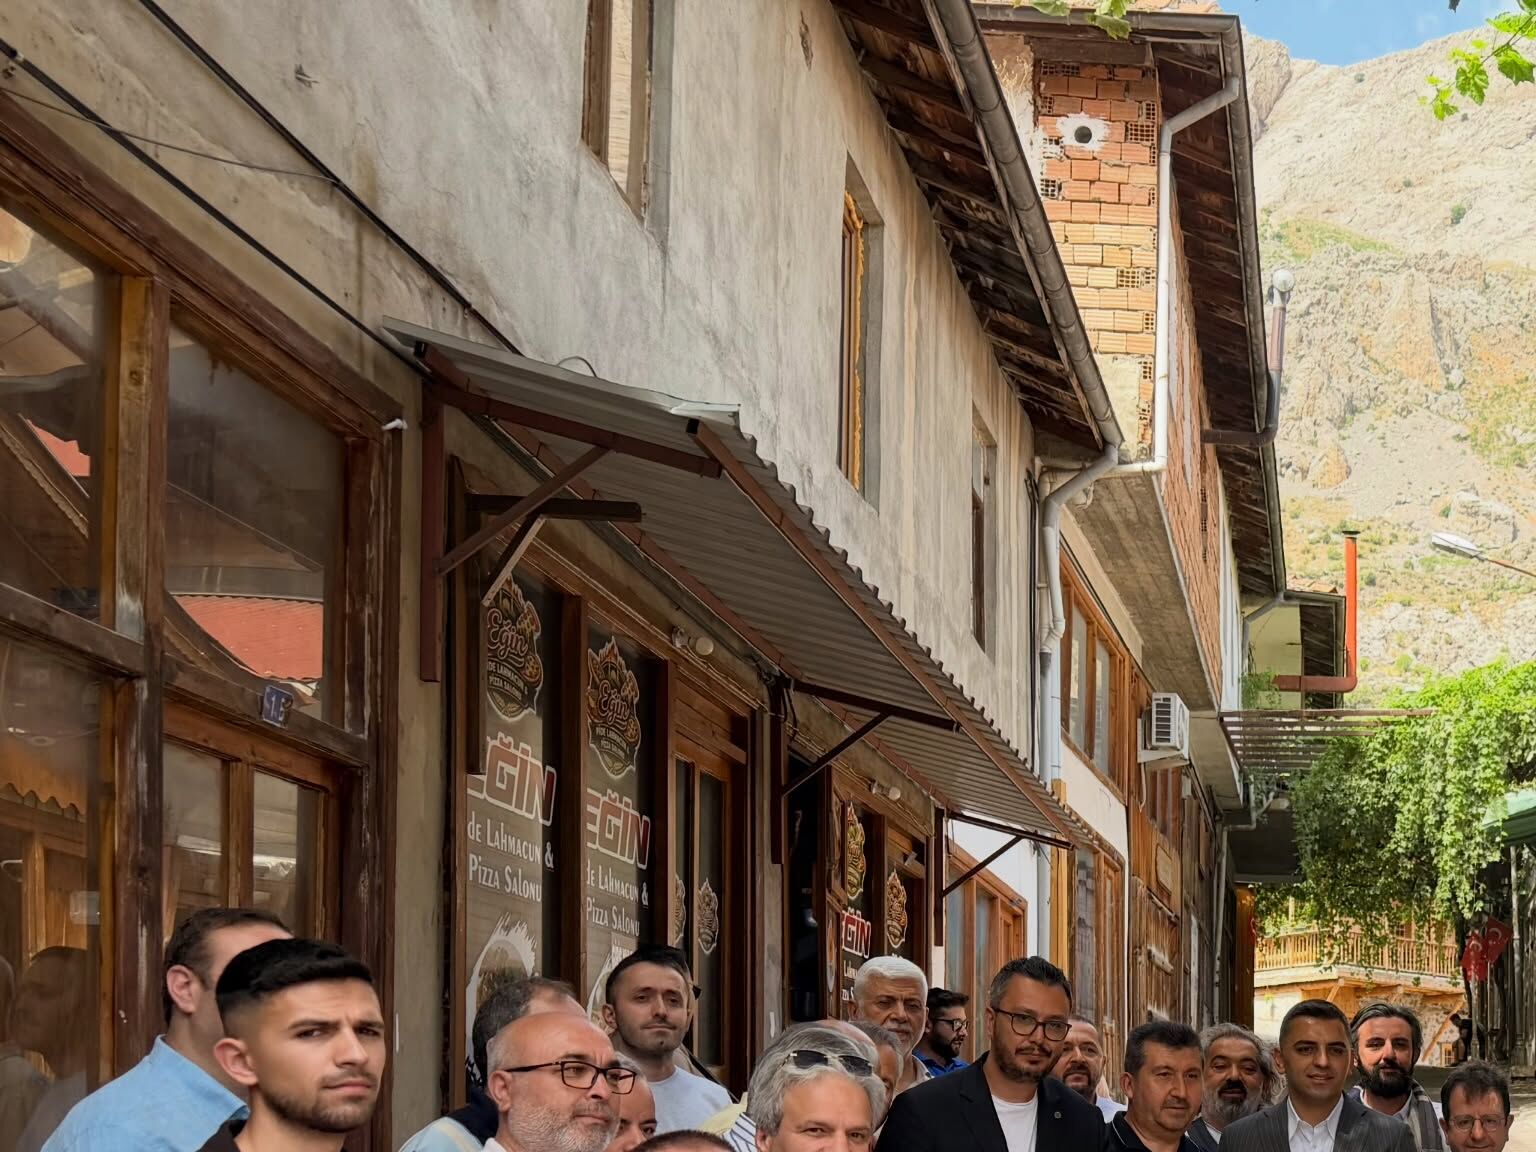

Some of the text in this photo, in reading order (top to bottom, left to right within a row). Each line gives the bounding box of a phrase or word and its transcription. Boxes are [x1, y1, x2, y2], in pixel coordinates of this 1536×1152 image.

[488, 607, 528, 660] Eğin
[598, 680, 630, 725] Eğin
[545, 842, 554, 869] &
[641, 882, 649, 906] &
